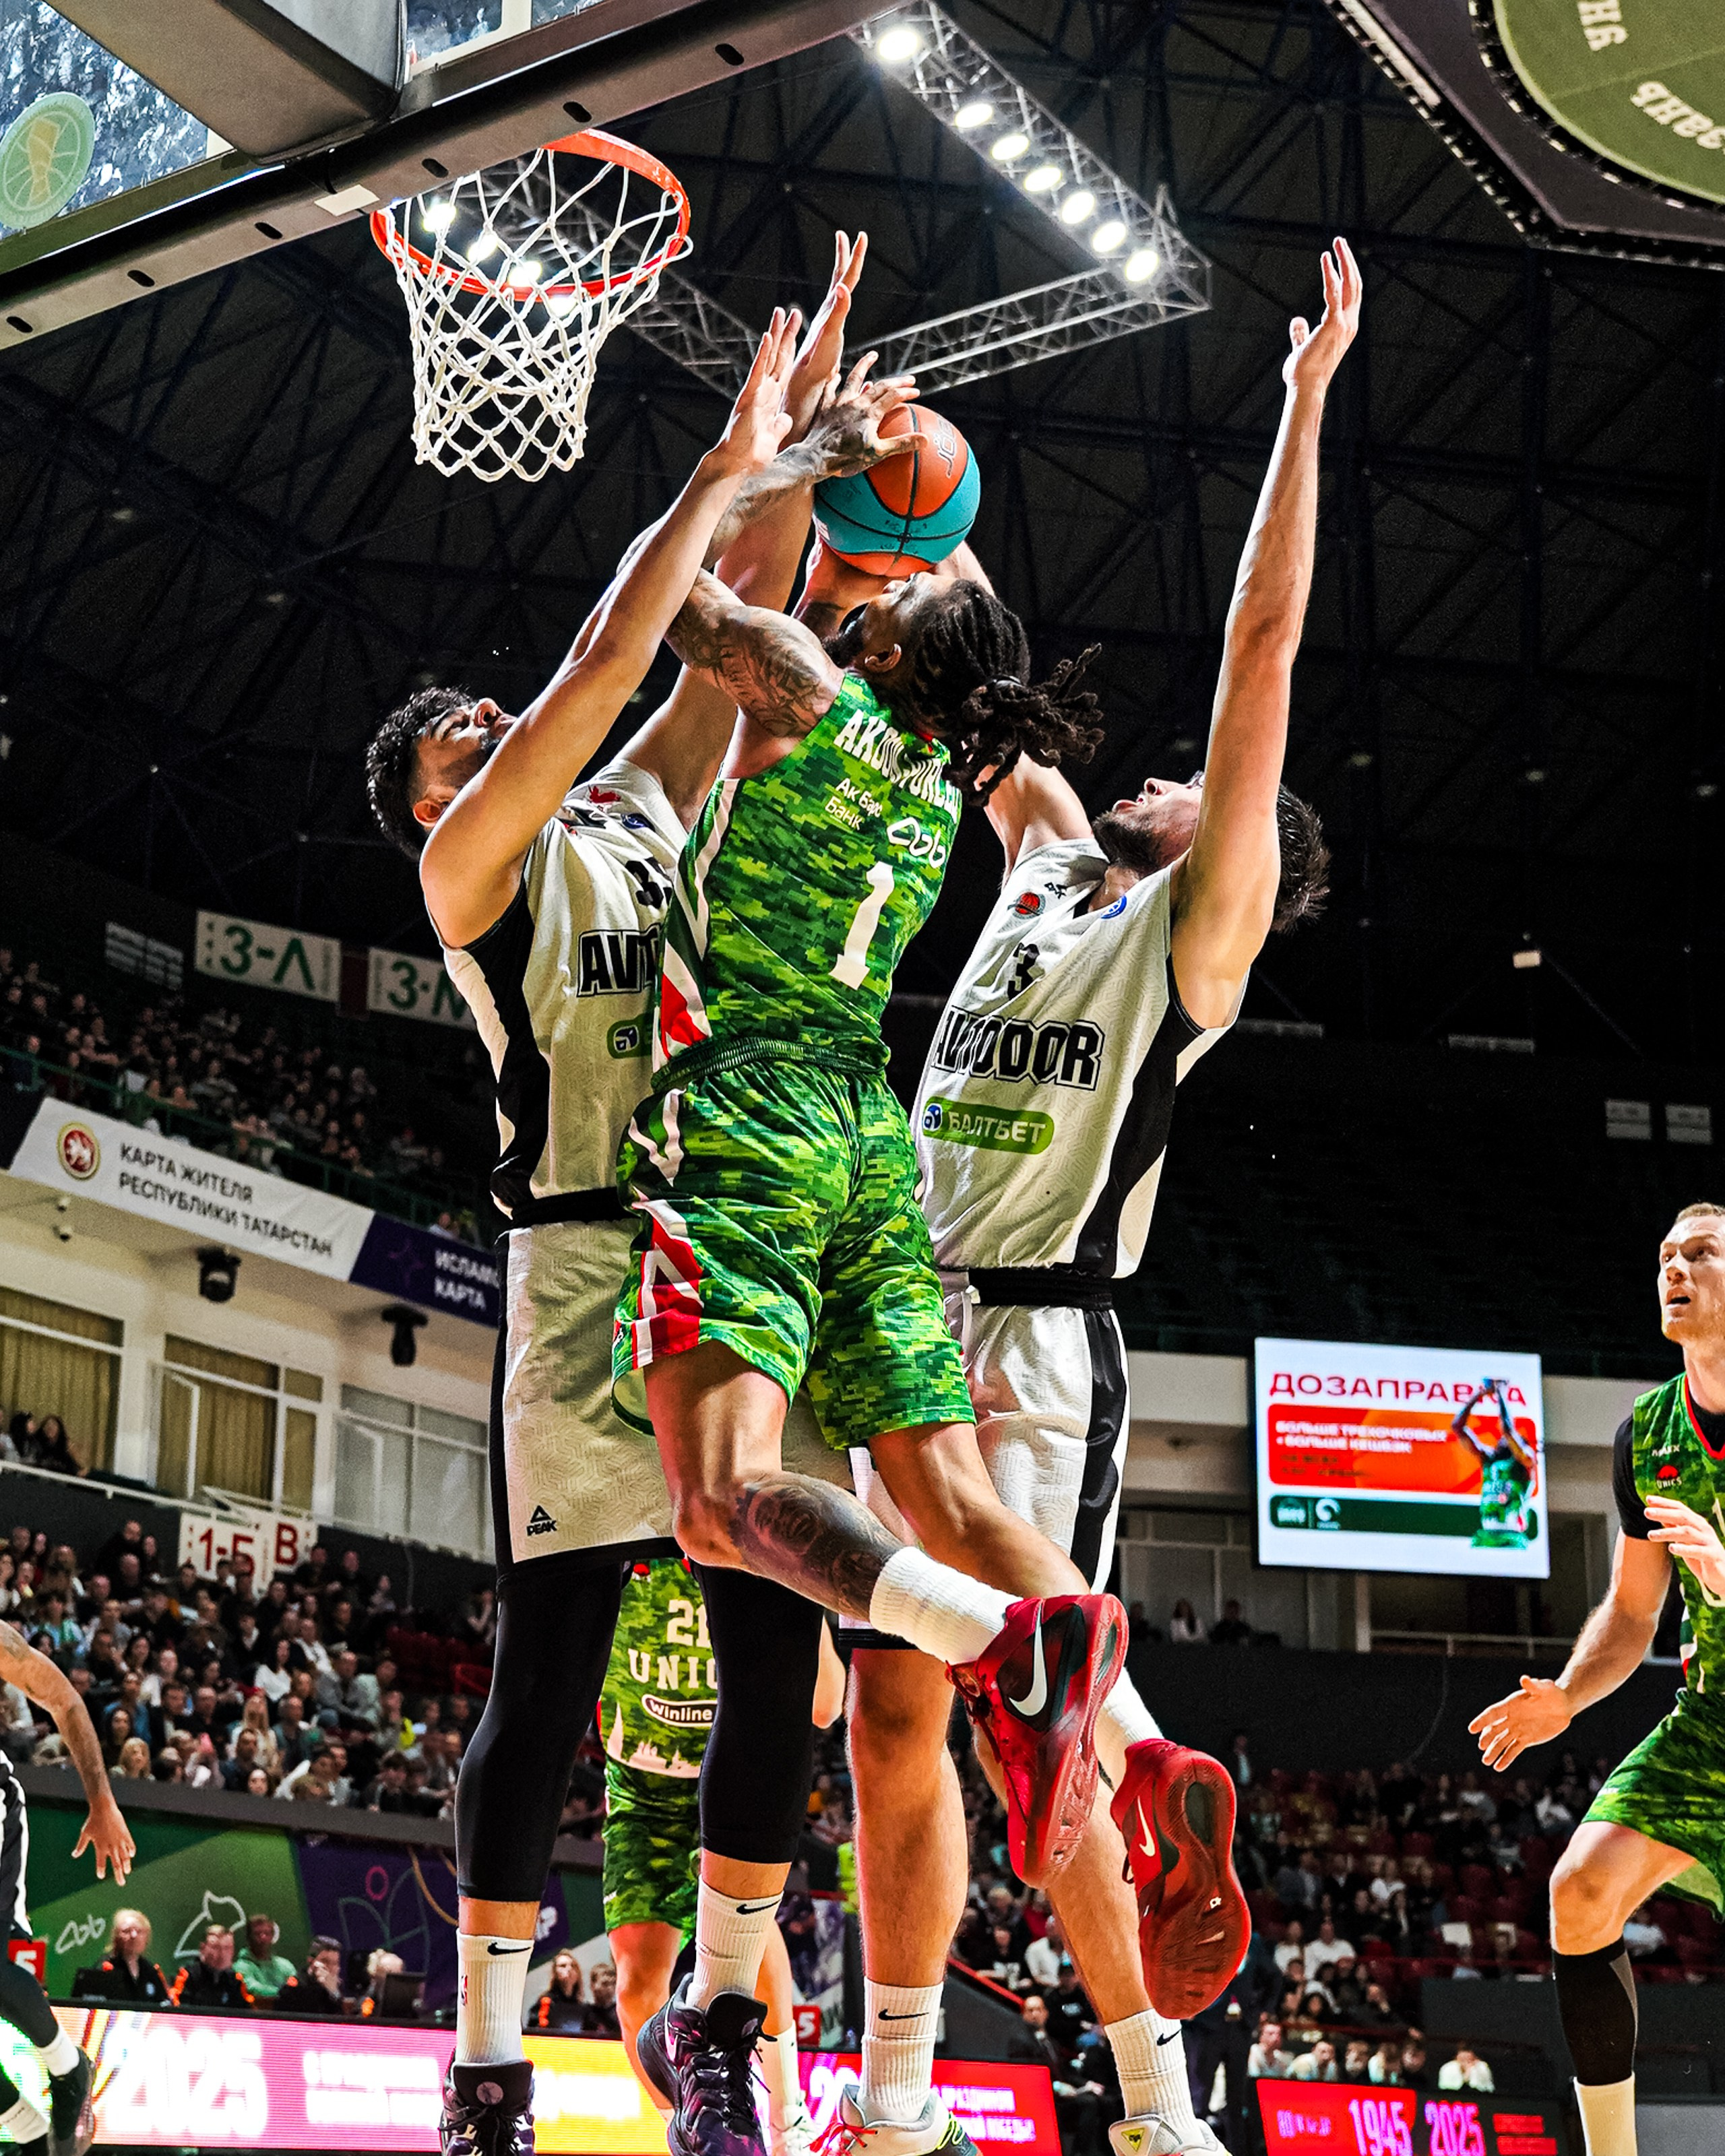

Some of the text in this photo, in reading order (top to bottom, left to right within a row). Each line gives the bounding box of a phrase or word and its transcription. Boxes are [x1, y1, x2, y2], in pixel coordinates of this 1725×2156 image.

[825, 795, 865, 830] Банк
[836, 778, 883, 818] Ак Барс
[828, 861, 895, 990] 1
[1007, 942, 1040, 1001] 3
[947, 1112, 1046, 1145] БАЛТБЕТ
[120, 1143, 253, 1205] КАРТА ЖИТЕЛЯ
[119, 1172, 333, 1259] РЕСПУБЛИКИ ТАТАРСТАН
[435, 1276, 487, 1310] КАРТА
[526, 1520, 558, 1537] PEAK
[15, 1950, 37, 1975] 5
[797, 2012, 816, 2039] 5
